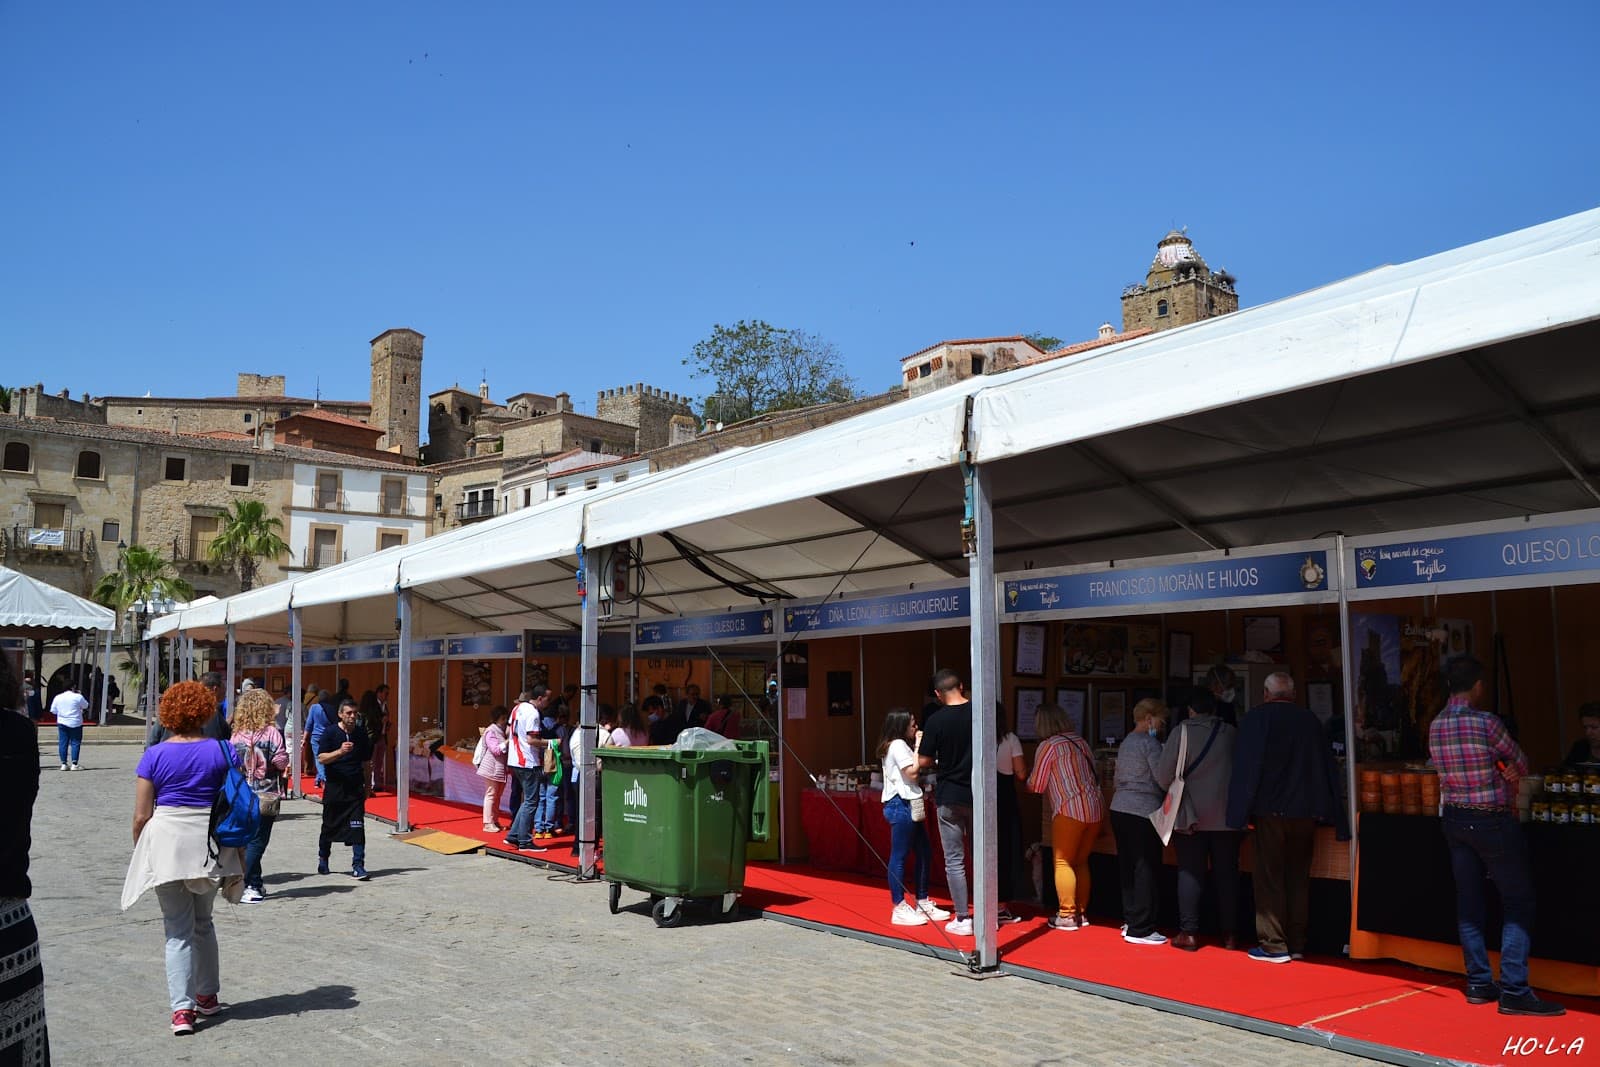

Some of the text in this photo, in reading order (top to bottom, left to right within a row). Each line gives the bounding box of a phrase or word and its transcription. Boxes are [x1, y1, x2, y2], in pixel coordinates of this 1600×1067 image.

[1502, 539, 1570, 565] QUESO
[1089, 576, 1156, 600] FRANCISCO
[1207, 572, 1217, 589] E
[1219, 567, 1259, 587] HIJOS
[1412, 559, 1446, 582] Trujillo
[892, 595, 959, 617] ALBURQUERQUE
[624, 779, 648, 810] trujillo
